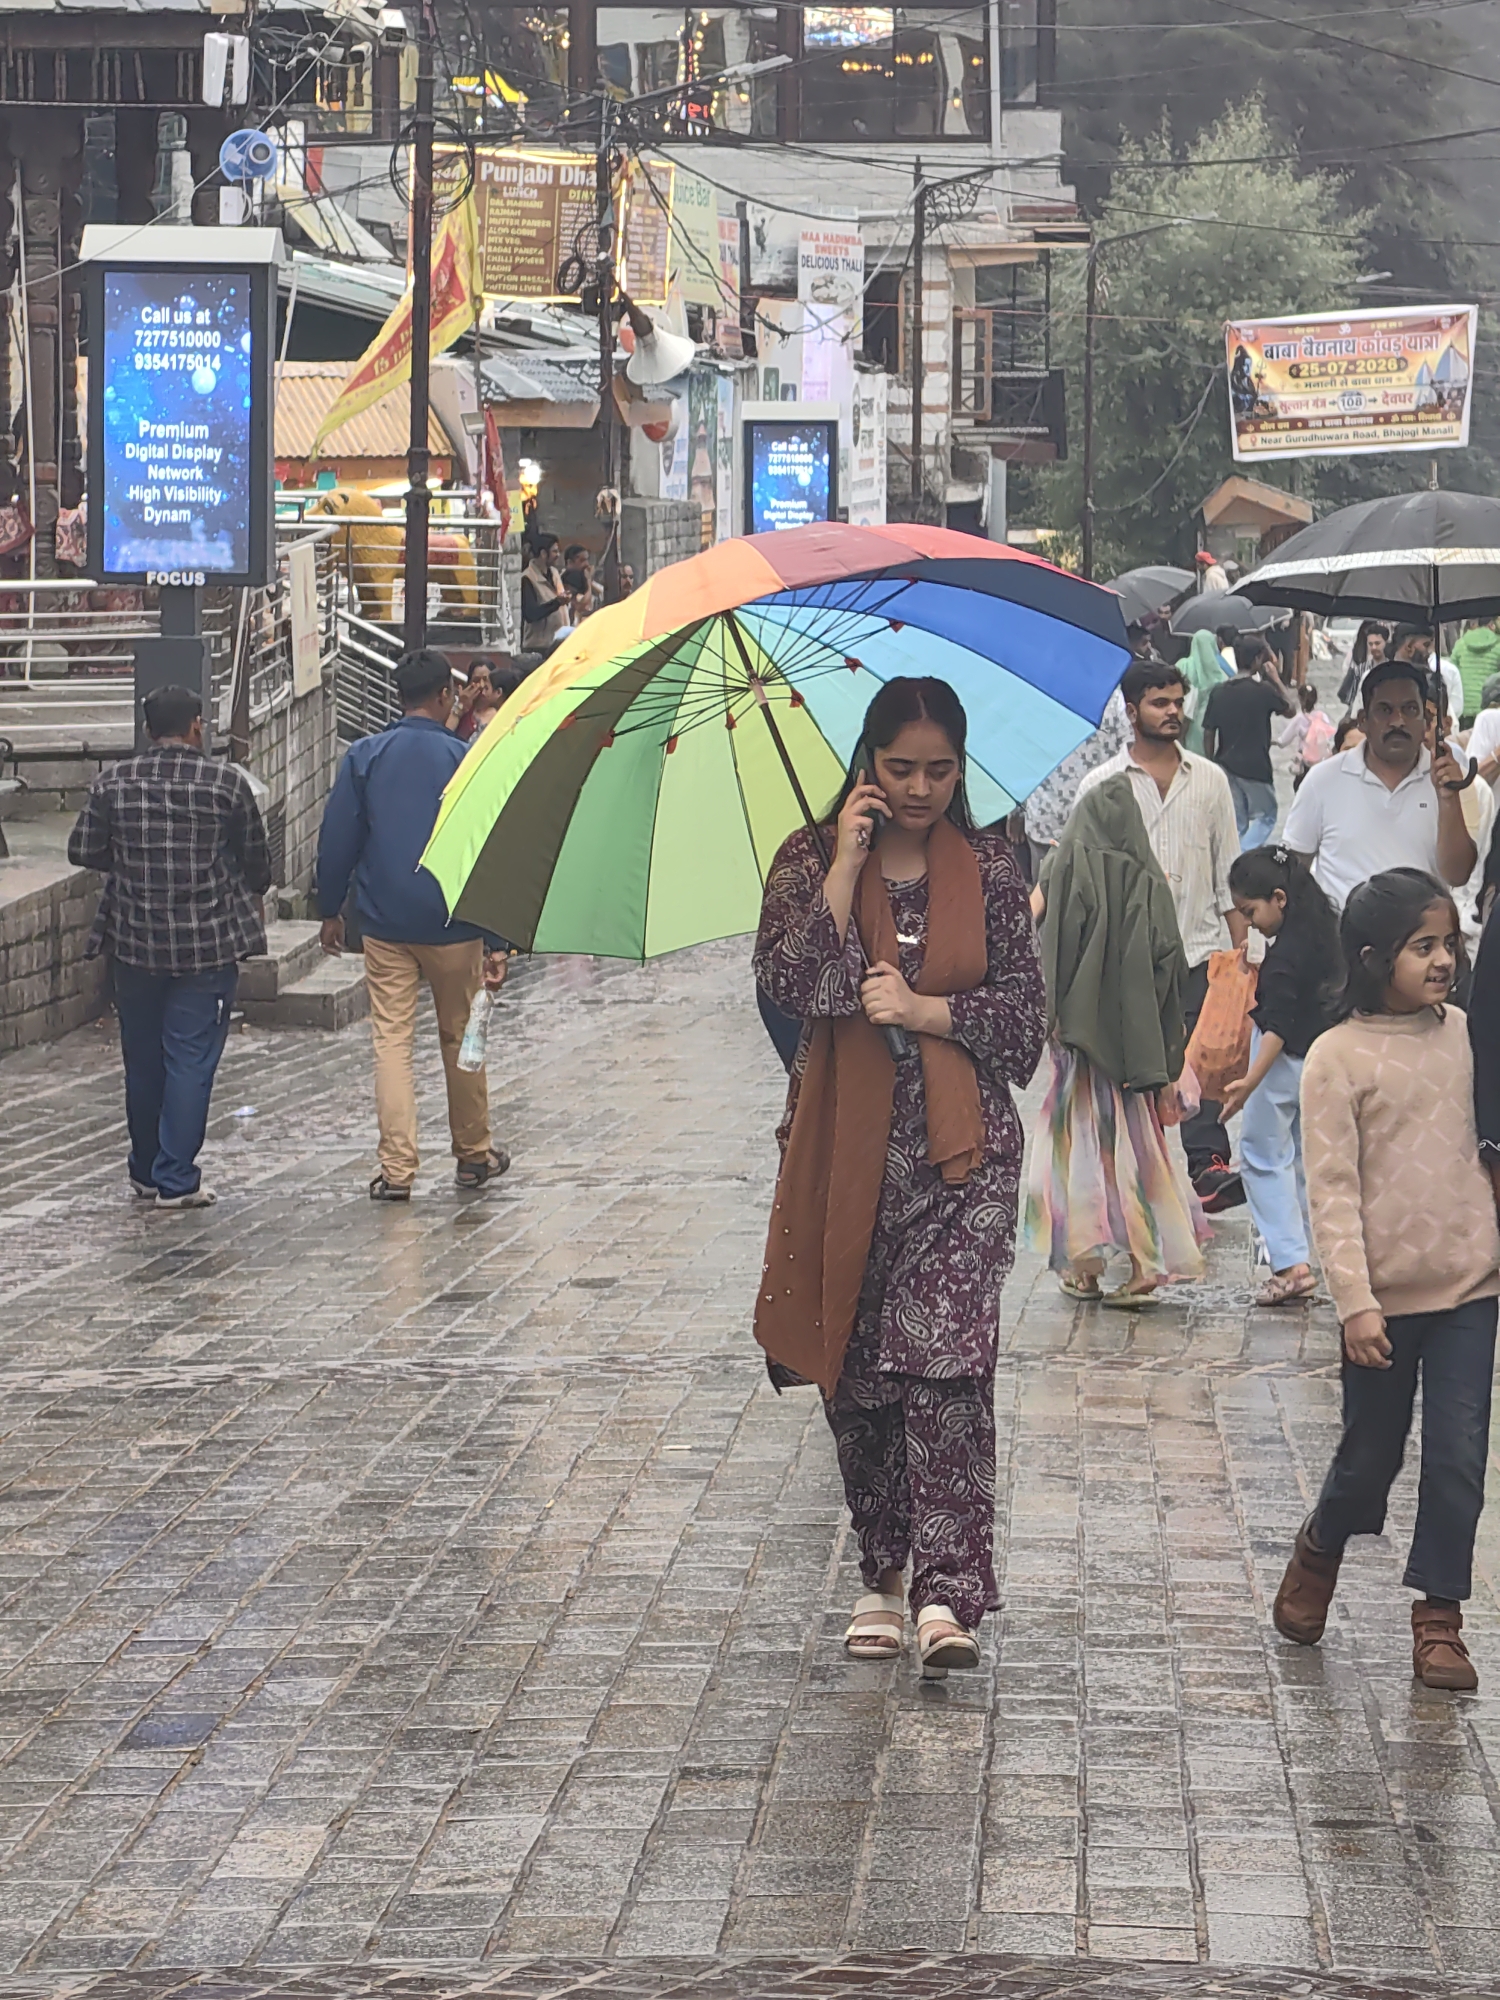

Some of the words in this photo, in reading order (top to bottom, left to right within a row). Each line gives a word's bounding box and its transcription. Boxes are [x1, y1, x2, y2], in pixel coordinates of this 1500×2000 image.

[480, 161, 554, 186] Punjabi
[560, 165, 597, 187] Dha
[503, 186, 538, 199] LUNCH
[696, 180, 711, 207] Bar
[801, 230, 820, 243] MAA
[823, 232, 862, 245] HADIMBA
[814, 244, 849, 256] SWEETS
[487, 255, 513, 263] CHILLI
[801, 254, 839, 271] DELICIOUS
[841, 258, 862, 273] THALI
[520, 284, 542, 293] LIVER
[141, 307, 170, 324] Call
[174, 312, 192, 324] us
[195, 308, 211, 325] at
[134, 330, 221, 348] 7277510000
[1263, 342, 1298, 360] बाबा
[1302, 336, 1357, 357] बैद्यनाथ
[1405, 332, 1441, 352] यात्रा
[134, 352, 221, 371] 9354175014
[1304, 378, 1337, 389] मनाली
[1341, 398, 1363, 408] 108
[138, 420, 210, 439] Premium
[1261, 436, 1282, 445] Near
[1285, 433, 1349, 444] Gurudhuwara
[1422, 425, 1453, 436] Manali
[125, 443, 168, 463] Digital
[172, 444, 222, 463] Display
[771, 441, 787, 452] Call
[148, 464, 203, 480] Network
[129, 485, 160, 503] High
[164, 485, 222, 505] Visibility
[770, 500, 808, 510] Premium
[144, 506, 191, 526] Dynam
[763, 510, 786, 522] Digital
[147, 571, 206, 586] FOCUS
